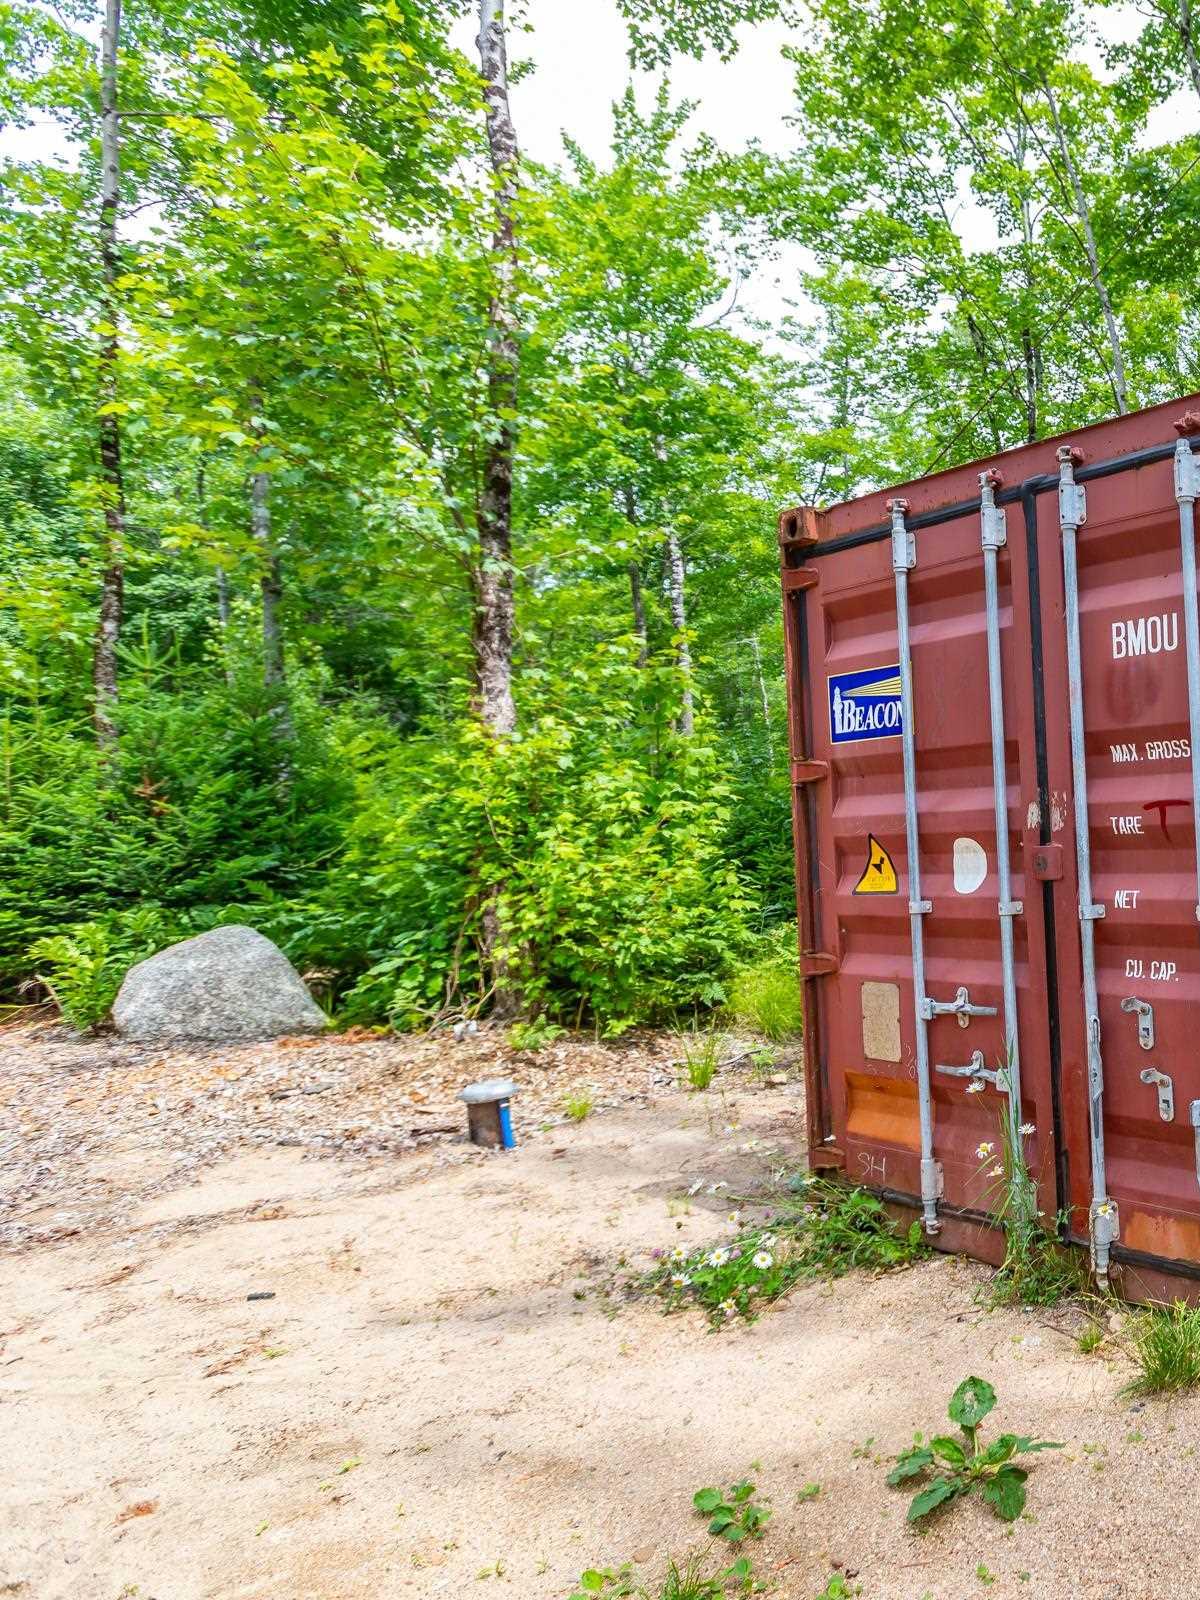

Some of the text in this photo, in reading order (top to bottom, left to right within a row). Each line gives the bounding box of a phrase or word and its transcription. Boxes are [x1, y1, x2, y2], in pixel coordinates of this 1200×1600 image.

[1112, 613, 1178, 659] BMOU
[1110, 739, 1190, 762] MAX. GROSS
[1110, 816, 1144, 835] TARE
[1114, 890, 1140, 909] NET
[1126, 960, 1179, 981] CU. CAP.
